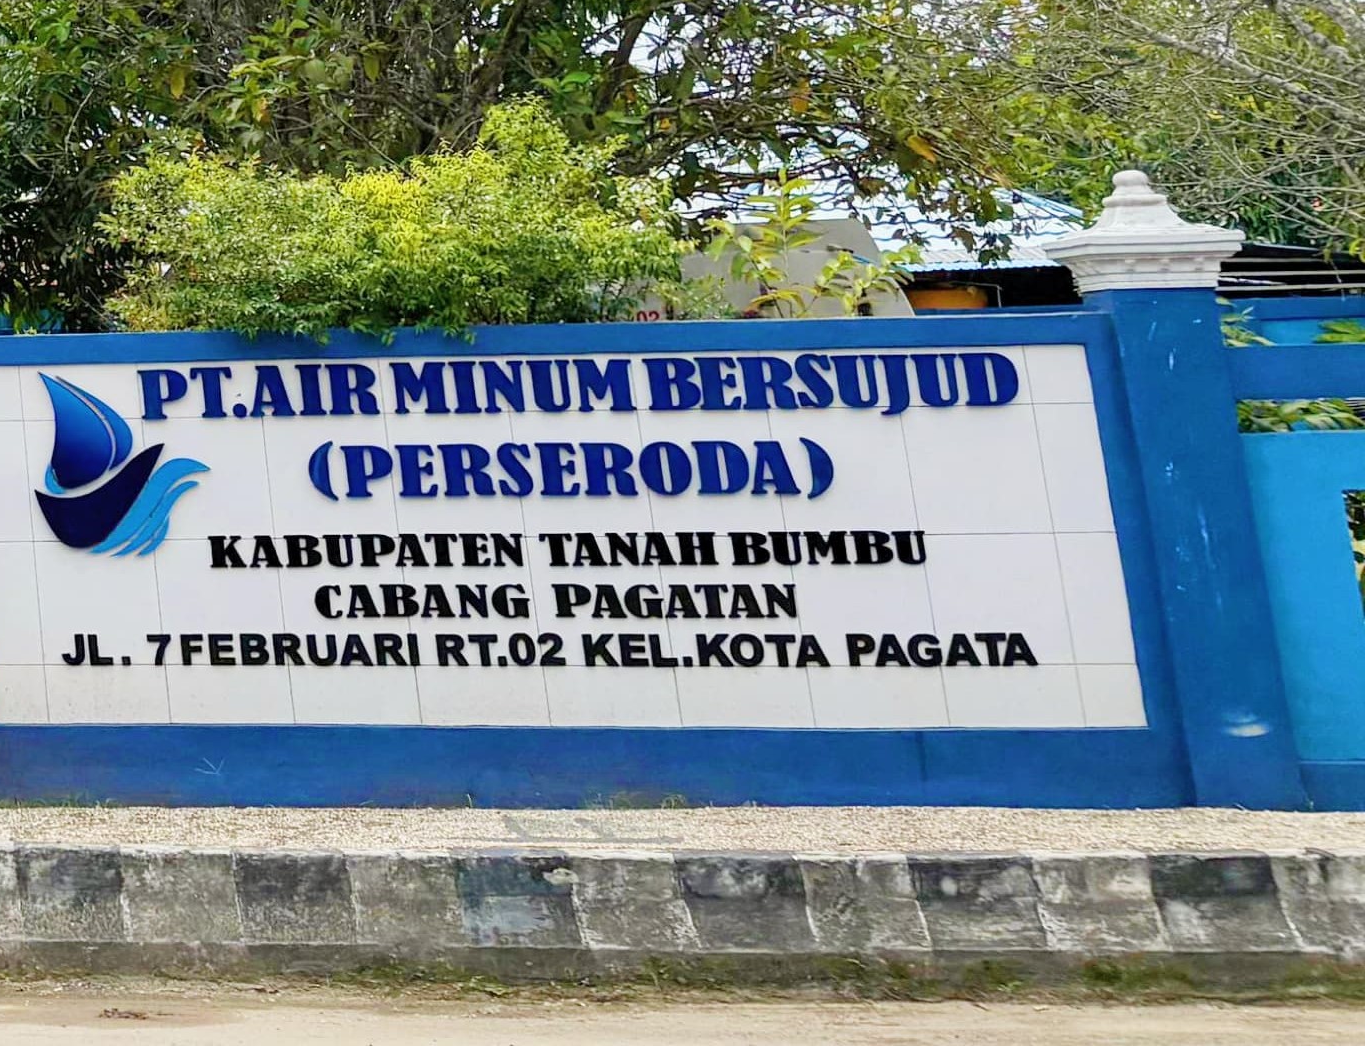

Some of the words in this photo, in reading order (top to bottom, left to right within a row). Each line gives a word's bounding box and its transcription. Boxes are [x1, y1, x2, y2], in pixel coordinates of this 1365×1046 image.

[389, 359, 637, 414] MINUM
[642, 353, 1019, 417] BERSUJUD
[309, 437, 834, 501] (PERSERODA)
[208, 533, 525, 569] KABUPATEN
[539, 531, 719, 567] TANAH
[728, 530, 927, 566] BUMBU
[314, 584, 530, 619] CABANG
[552, 584, 797, 619] PAGATAN
[62, 634, 131, 666] JL.
[435, 632, 566, 667] RT.02
[846, 632, 1039, 667] PAGATA
